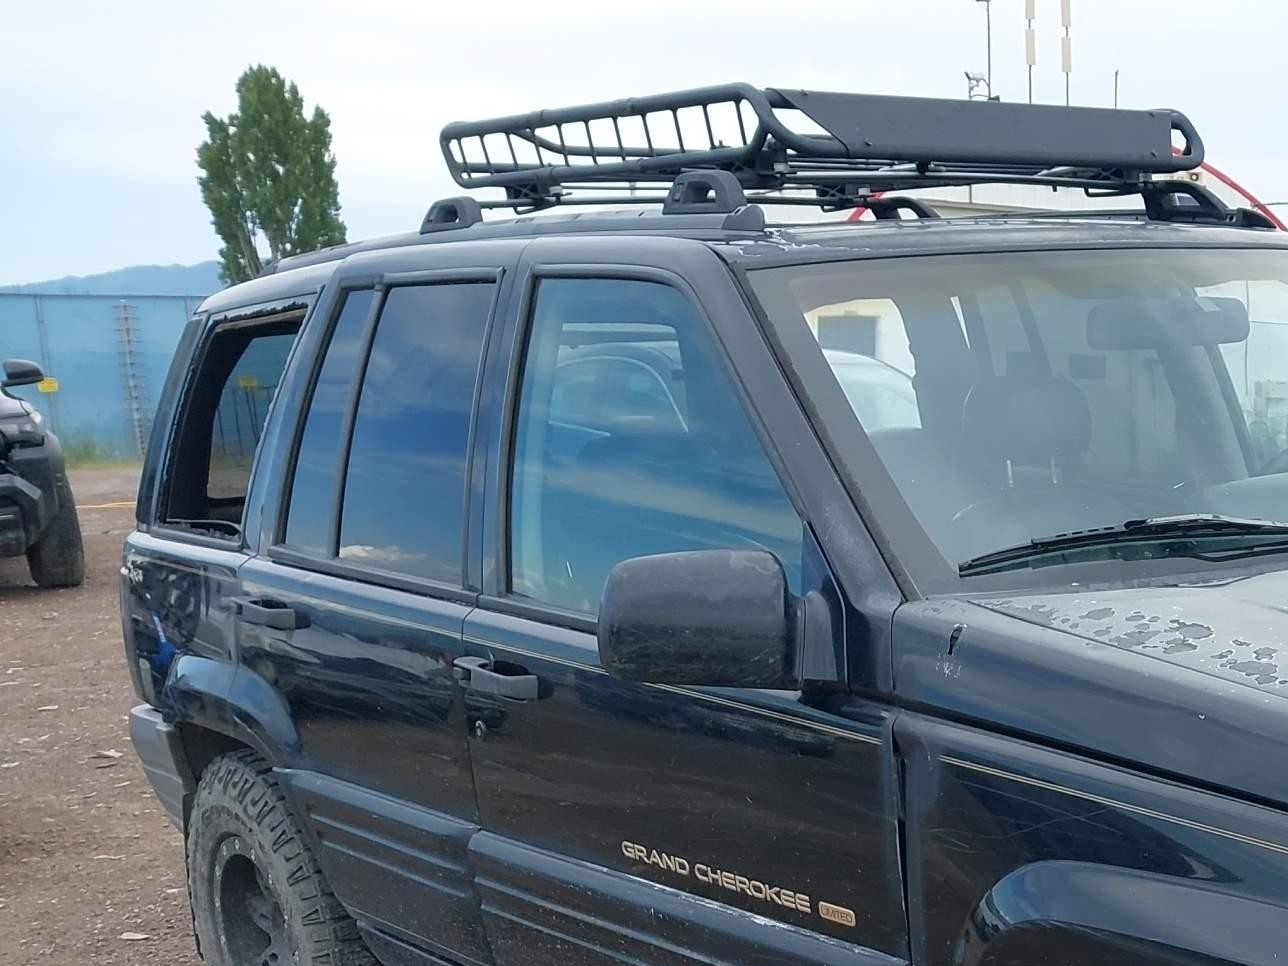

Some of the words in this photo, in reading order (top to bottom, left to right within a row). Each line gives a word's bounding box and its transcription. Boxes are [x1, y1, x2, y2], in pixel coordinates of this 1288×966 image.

[621, 840, 689, 875] GRAND
[694, 863, 812, 914] CHEROKEE
[820, 903, 854, 925] LIMITED
